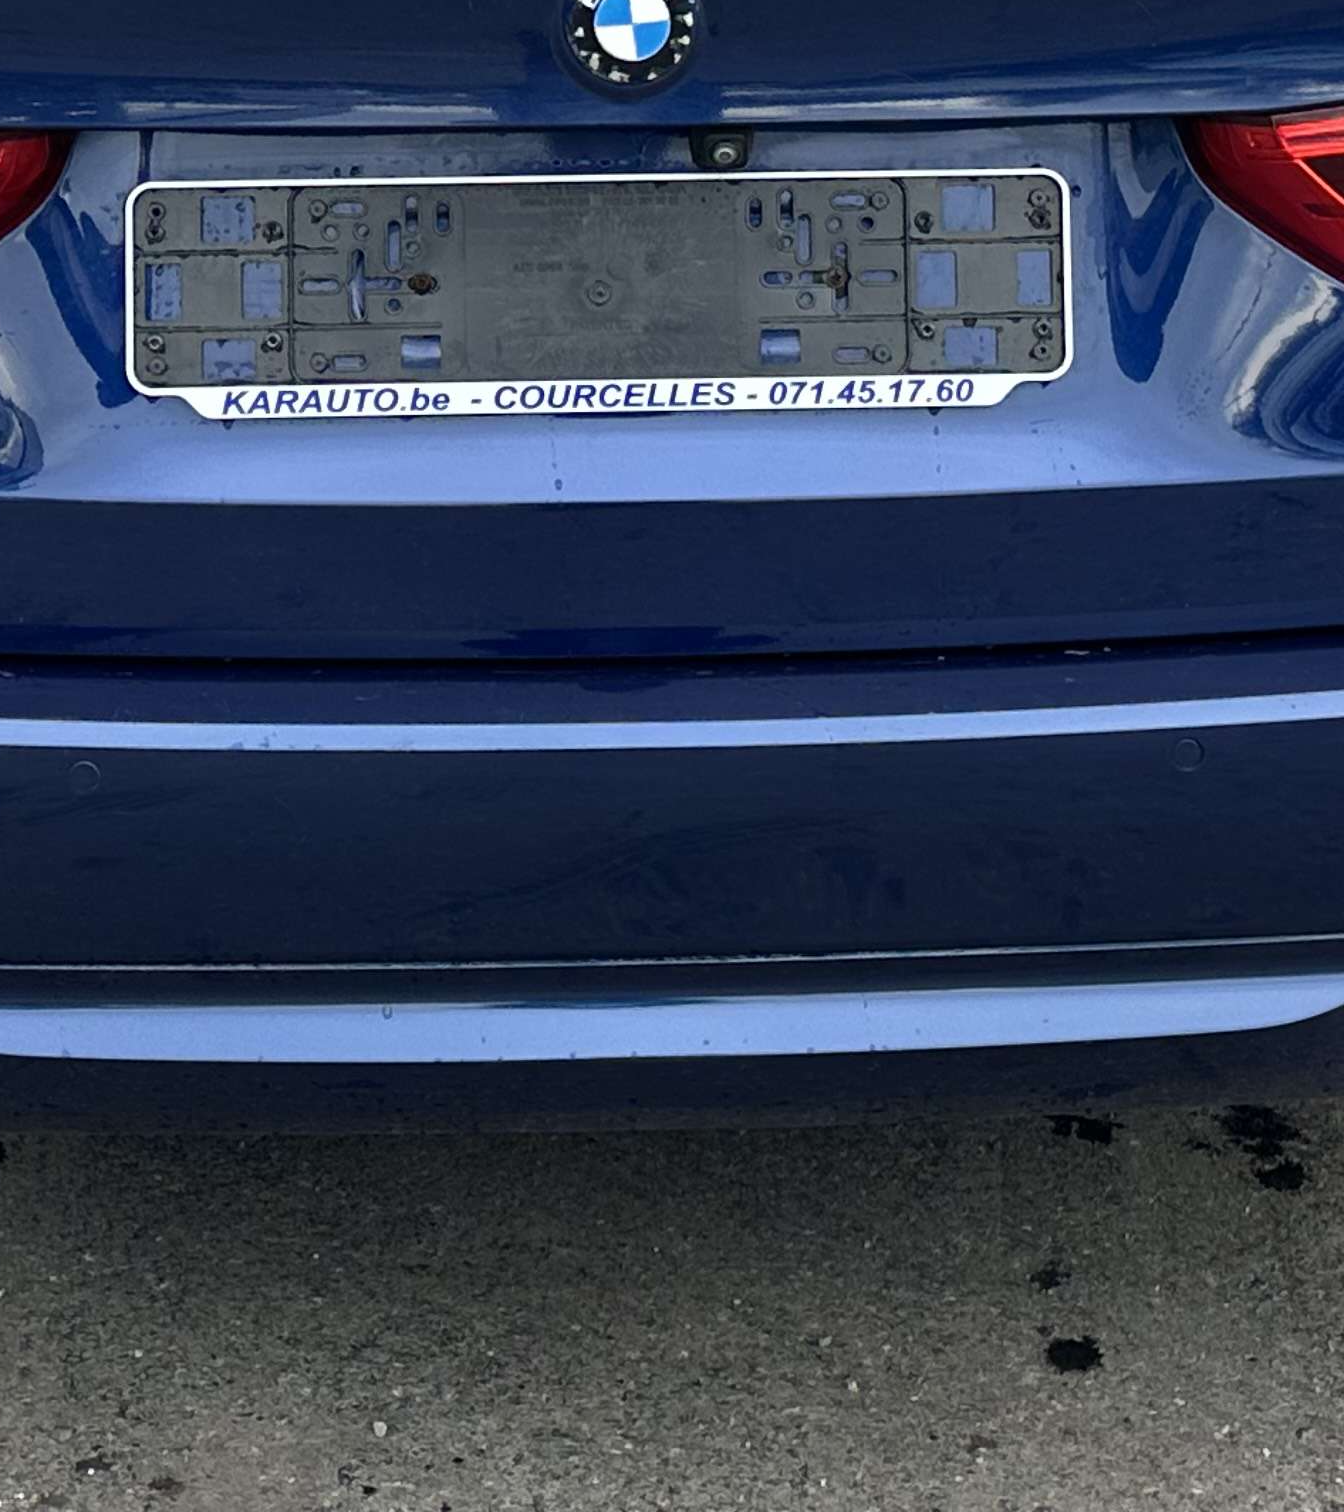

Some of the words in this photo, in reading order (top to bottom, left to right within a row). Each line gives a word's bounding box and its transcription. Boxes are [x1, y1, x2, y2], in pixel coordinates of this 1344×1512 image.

[222, 387, 451, 416] KARAUTO.be
[494, 382, 737, 410] COURCELLES
[768, 378, 975, 405] 071.45.17.60
